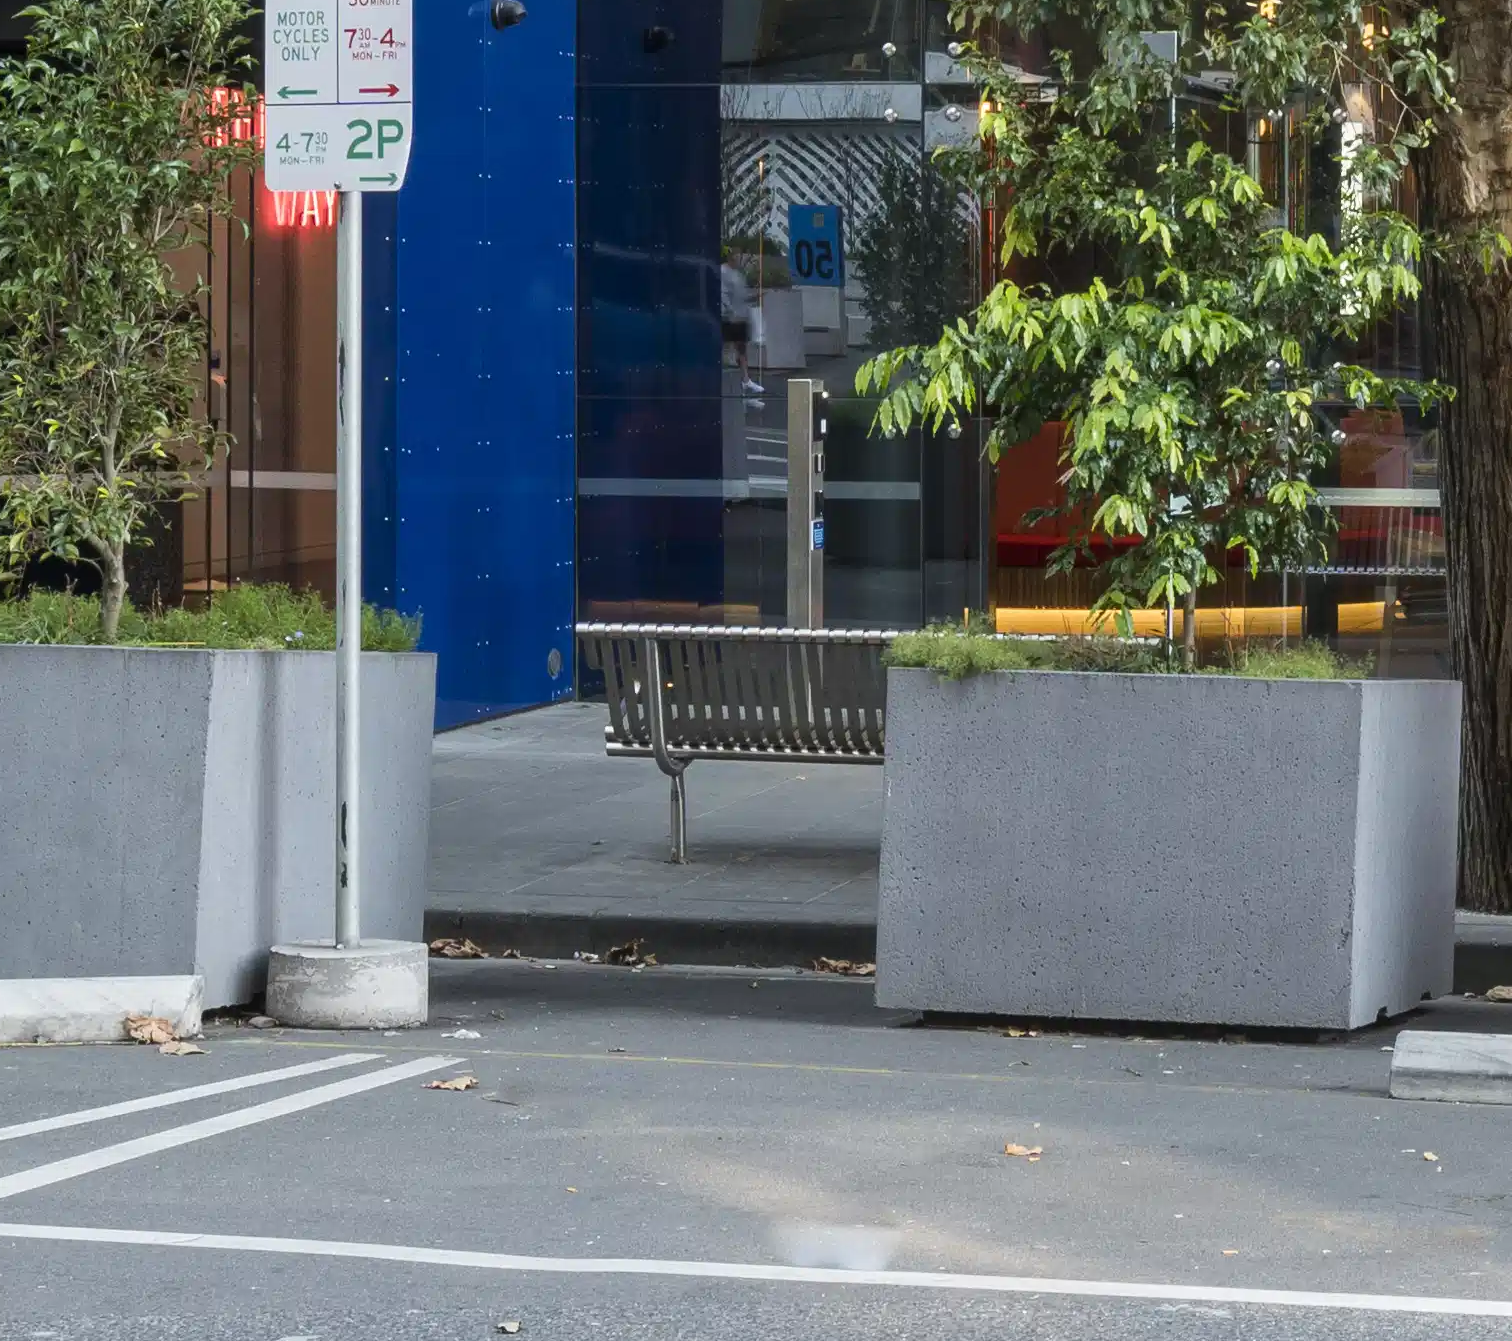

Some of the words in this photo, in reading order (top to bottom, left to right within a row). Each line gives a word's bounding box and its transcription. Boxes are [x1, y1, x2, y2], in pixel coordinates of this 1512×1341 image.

[277, 11, 325, 26] MOTOR
[273, 28, 329, 44] CYCLES
[281, 46, 320, 61] ONLY
[347, 119, 403, 159] 2P
